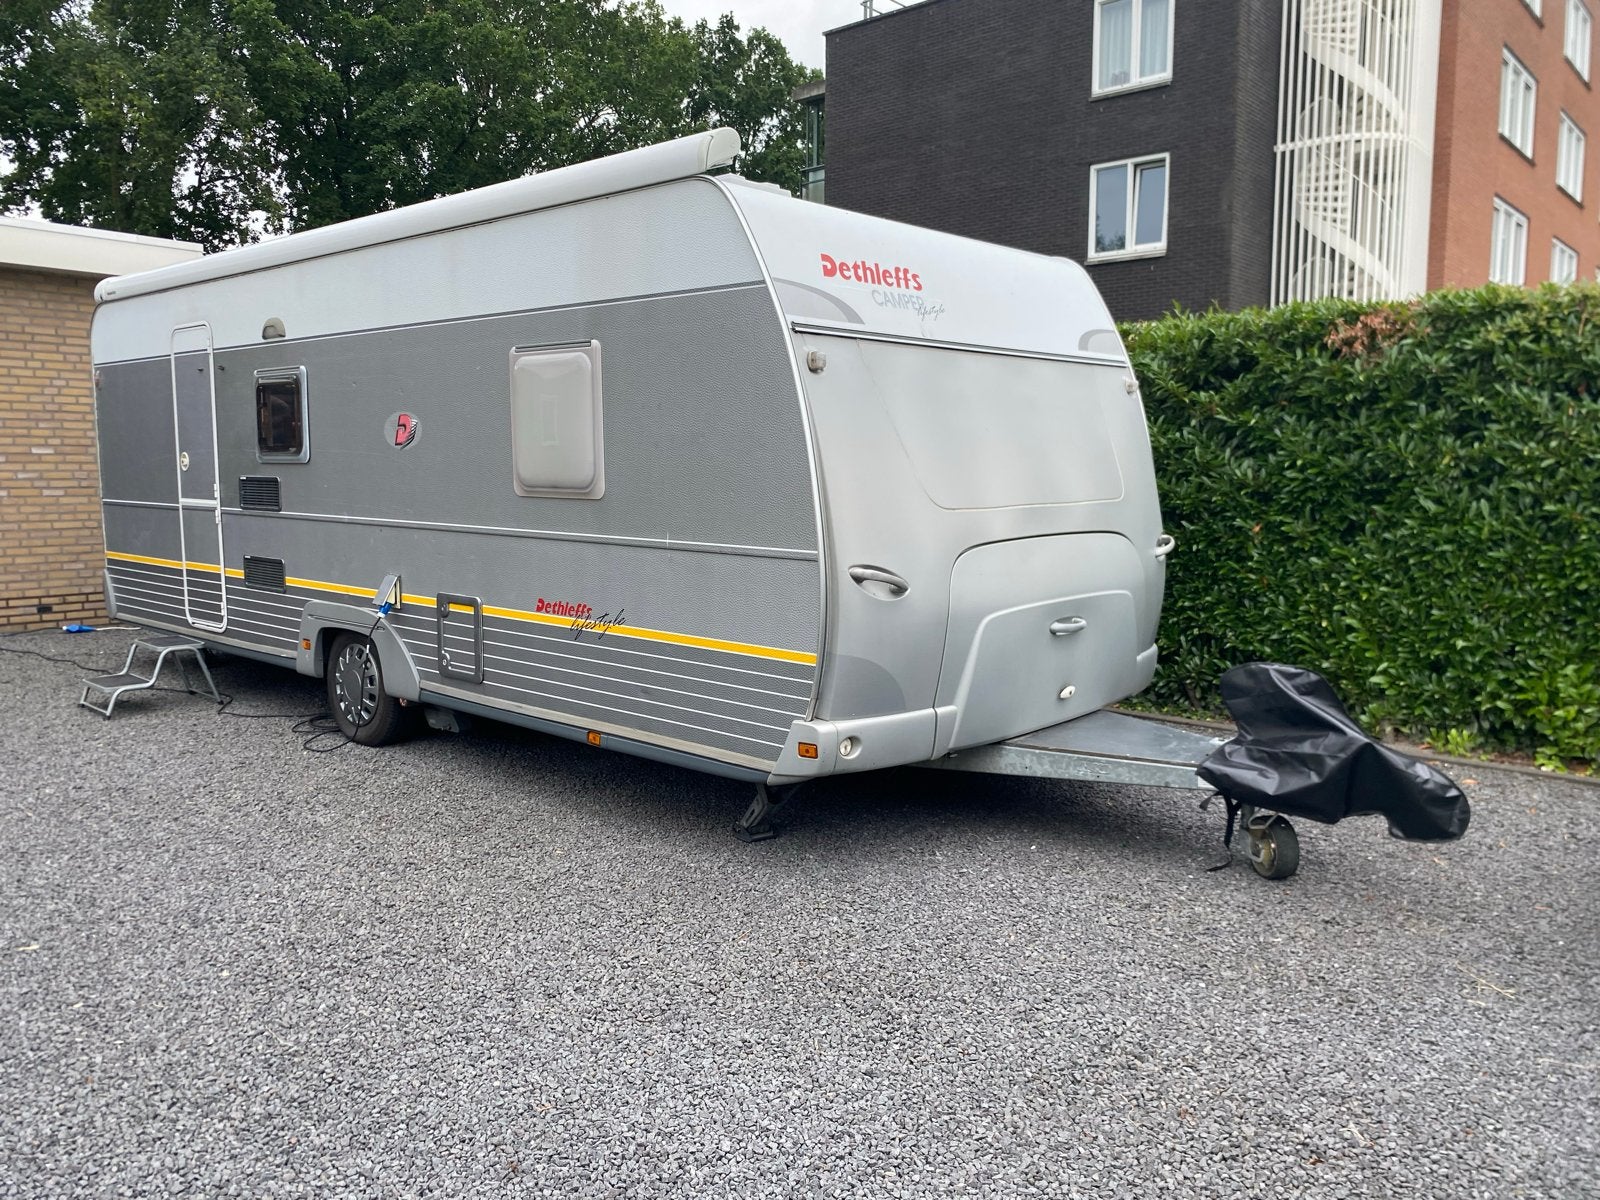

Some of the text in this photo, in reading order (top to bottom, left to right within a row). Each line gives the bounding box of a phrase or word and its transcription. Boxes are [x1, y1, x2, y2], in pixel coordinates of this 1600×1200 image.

[820, 253, 923, 292] Dethleffs
[871, 289, 925, 311] CAMPER
[916, 304, 946, 322] lifestyle
[535, 597, 593, 618] Dethleffs
[569, 608, 627, 641] lifestyle
